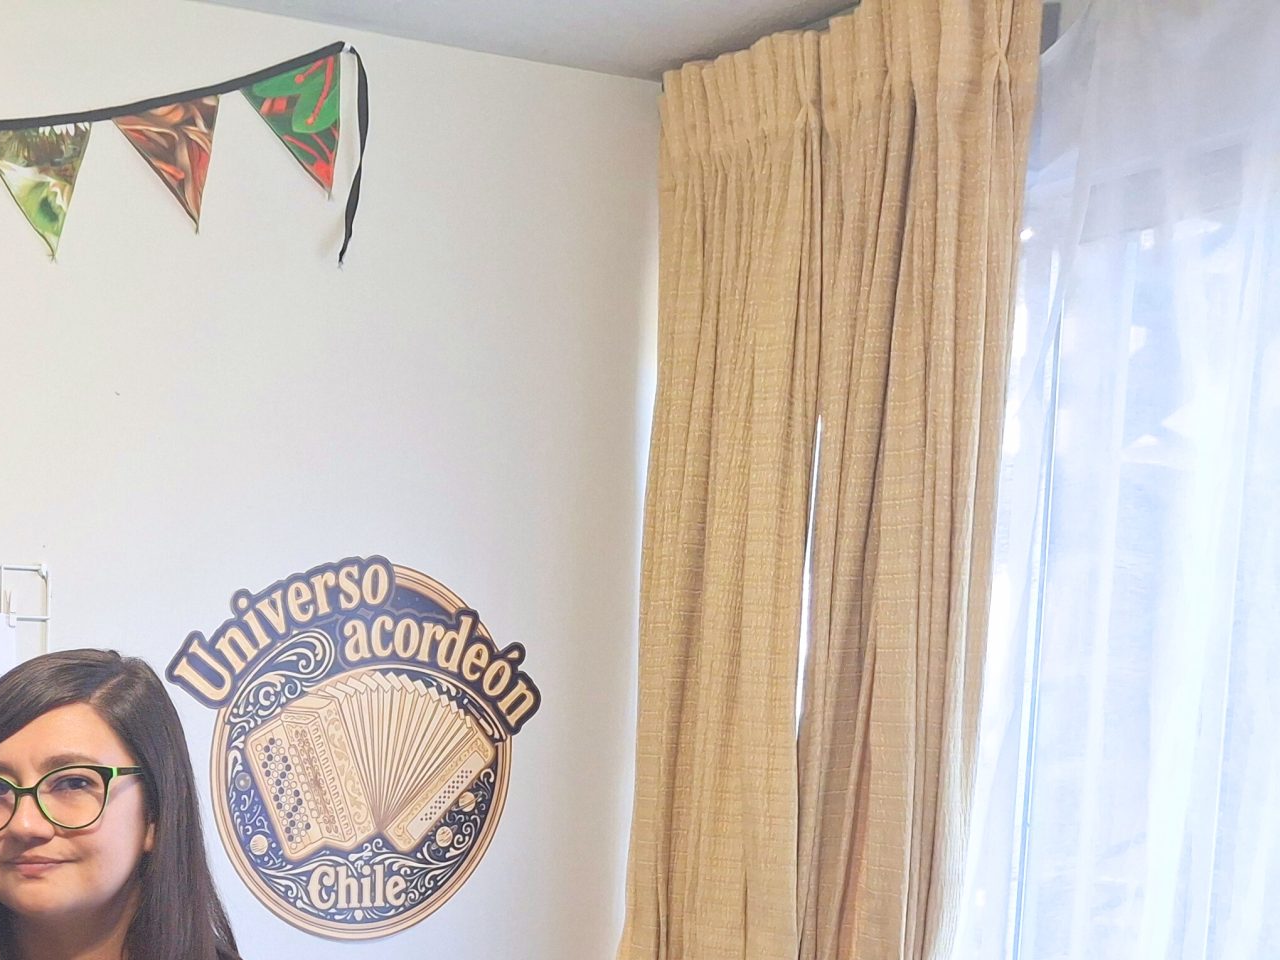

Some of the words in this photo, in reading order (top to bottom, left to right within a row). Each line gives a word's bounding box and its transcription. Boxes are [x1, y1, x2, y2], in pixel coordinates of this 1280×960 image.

[174, 563, 390, 704] Universo
[343, 615, 535, 727] acordeón
[306, 863, 409, 910] Chile
